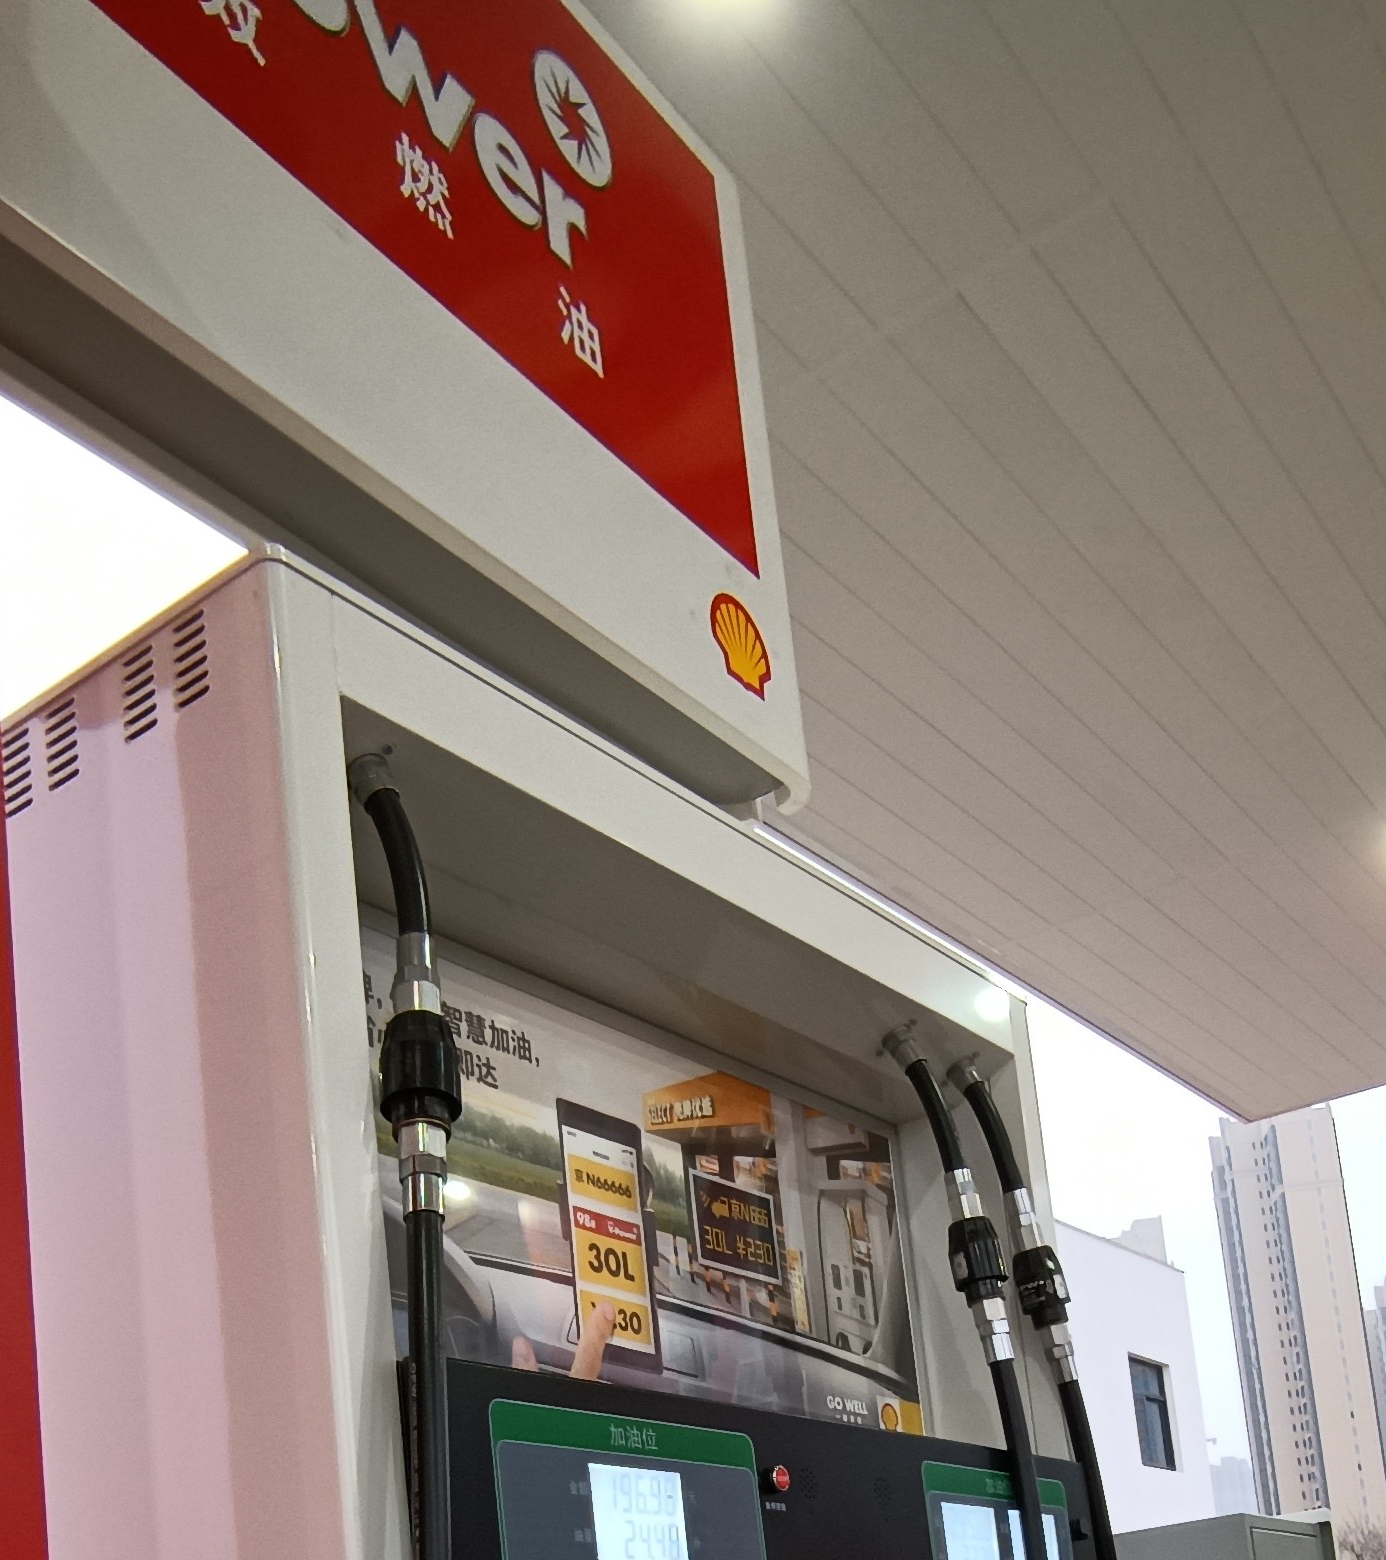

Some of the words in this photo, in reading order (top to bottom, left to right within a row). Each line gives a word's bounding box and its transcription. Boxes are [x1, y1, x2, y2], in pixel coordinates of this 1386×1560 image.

[587, 1242, 635, 1283] 30L
[826, 1395, 843, 1409] GO
[843, 1399, 869, 1415] WELL
